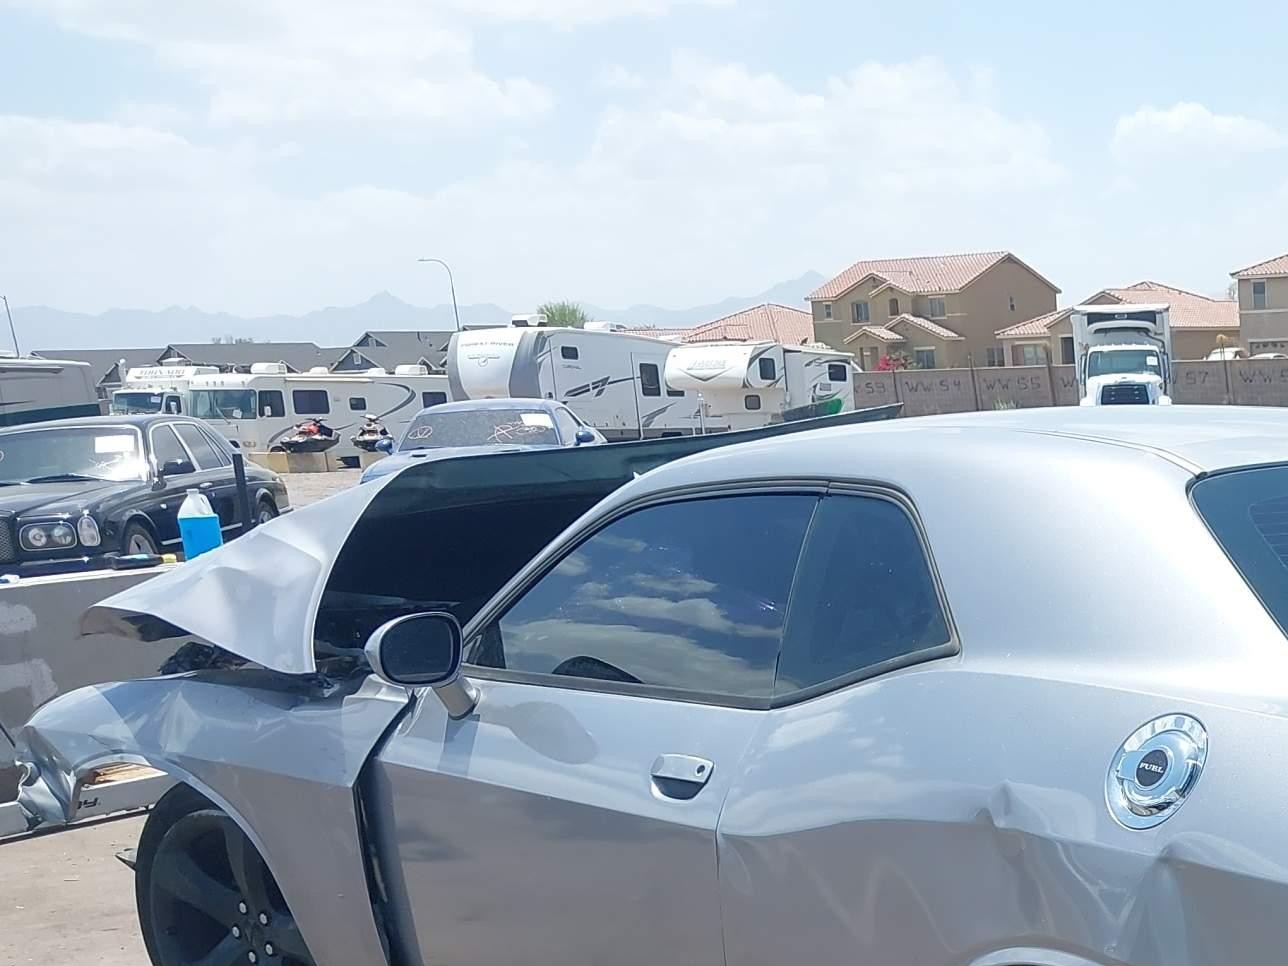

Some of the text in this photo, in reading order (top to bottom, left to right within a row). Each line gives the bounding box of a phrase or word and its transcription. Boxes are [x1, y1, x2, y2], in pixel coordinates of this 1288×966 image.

[1016, 376, 1041, 390] 55
[1185, 371, 1209, 385] 57
[1139, 761, 1164, 774] FUEL
